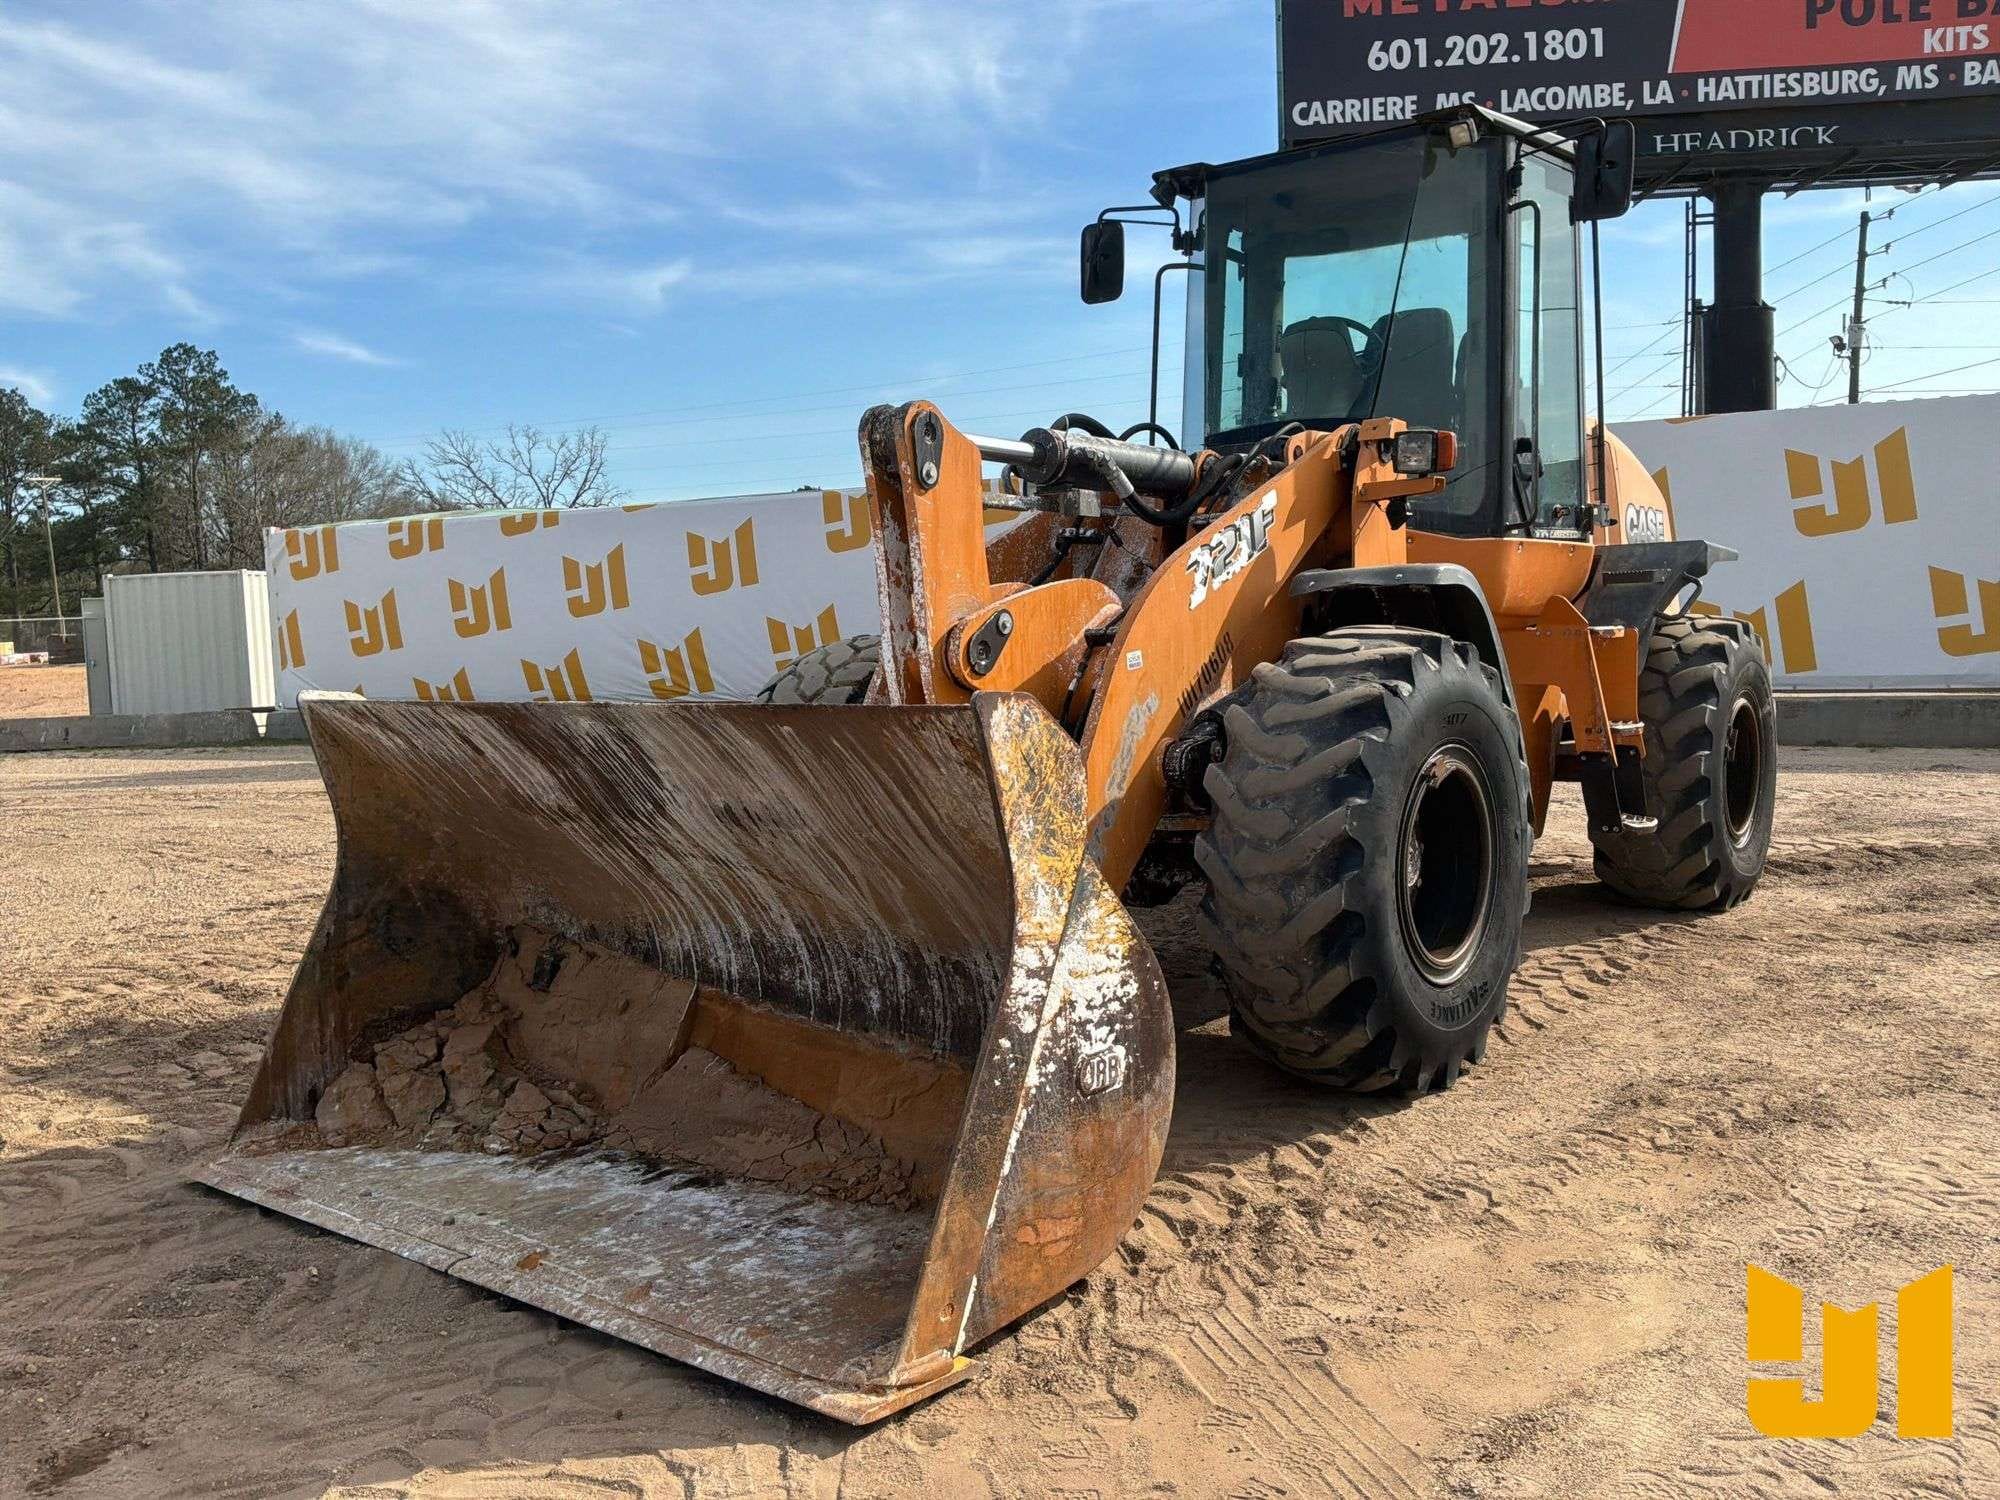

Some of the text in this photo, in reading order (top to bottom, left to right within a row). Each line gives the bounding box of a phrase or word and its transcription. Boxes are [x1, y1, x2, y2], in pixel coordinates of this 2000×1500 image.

[1367, 27, 1605, 71] 601.202.1801
[1923, 24, 1990, 53] KITS
[1500, 82, 1633, 114] LACOMBE,
[1642, 79, 1675, 105] LA
[1697, 67, 1888, 102] HATTIESBURG,
[1895, 64, 1939, 91] MS
[1652, 125, 1840, 153] HEADRICK
[1625, 503, 1665, 543] CASE
